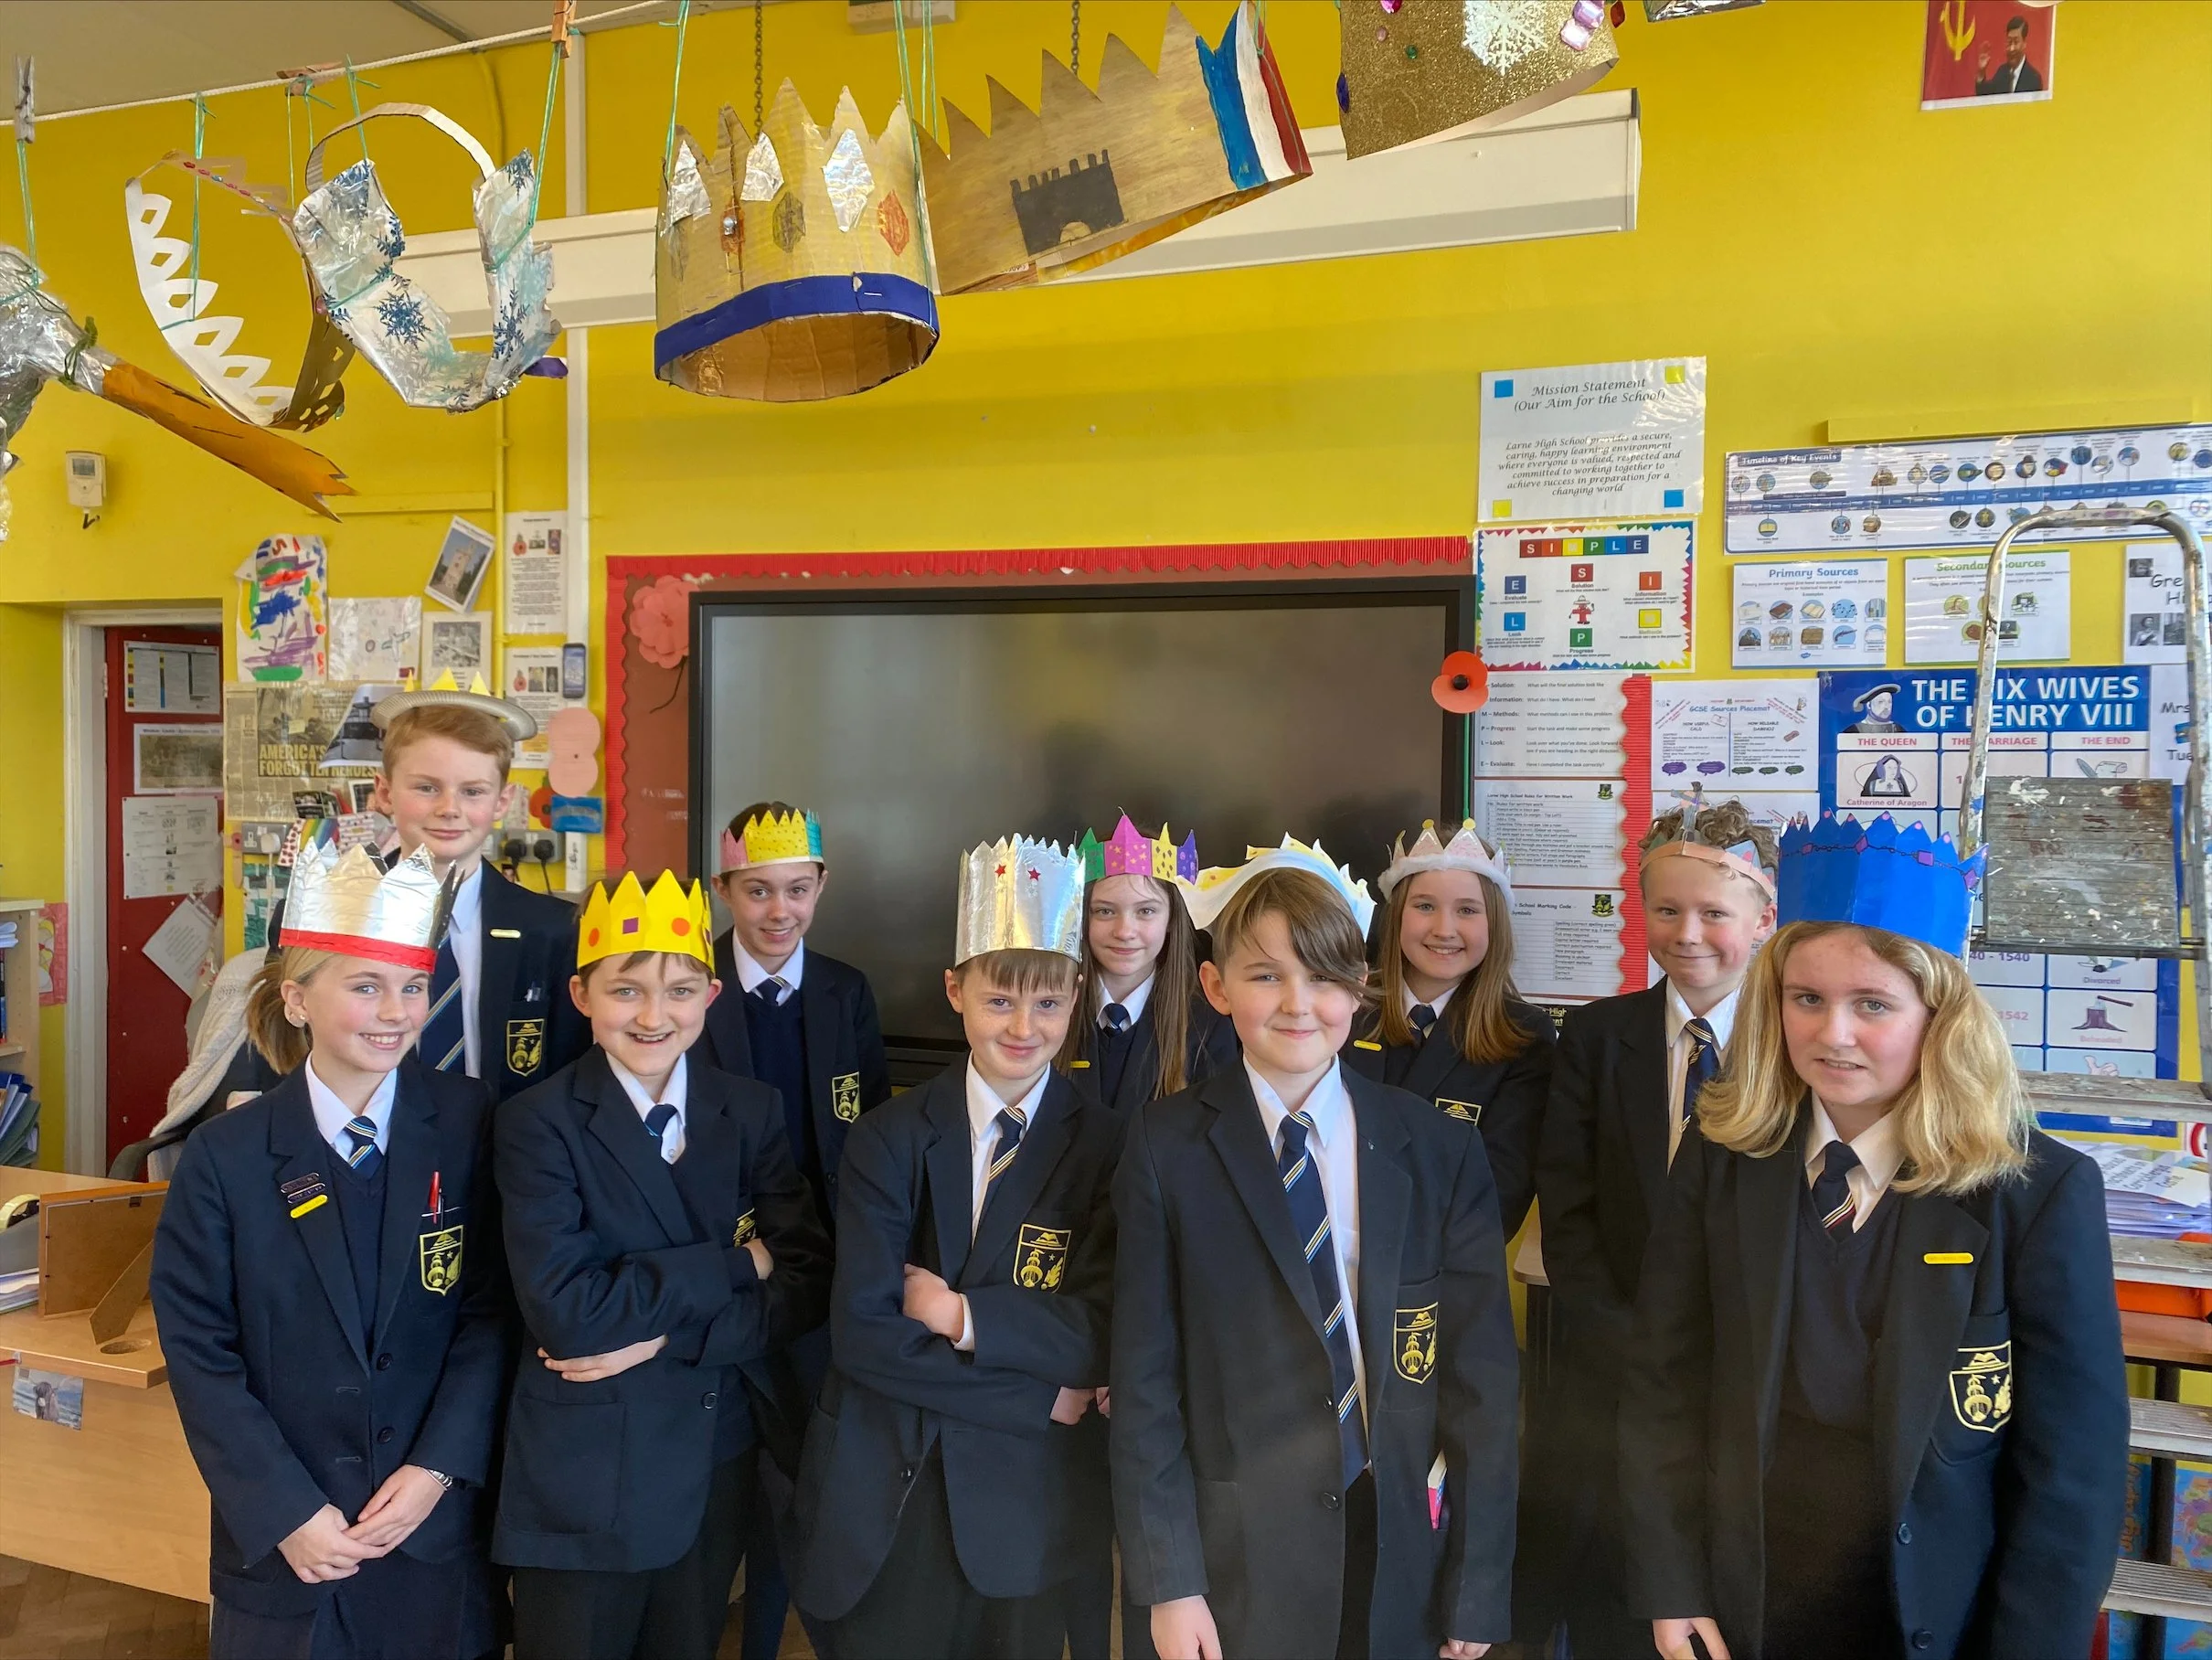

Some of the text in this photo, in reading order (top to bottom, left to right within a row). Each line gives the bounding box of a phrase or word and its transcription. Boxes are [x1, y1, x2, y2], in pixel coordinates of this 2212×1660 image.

[1531, 378, 1645, 397] Mission Statement
[1514, 389, 1665, 412] (Our Aim for the School)
[1506, 442, 1532, 451] Larne
[1535, 439, 1557, 450] High
[1559, 437, 1588, 446] School
[1506, 442, 1672, 461] caring, happy learning environment
[1742, 452, 1837, 465] Timeline of Key Events
[1498, 462, 1526, 470] where
[1527, 459, 1568, 469] everyone
[1581, 455, 1613, 464] valued,
[1617, 452, 1660, 463] respected
[1663, 451, 1681, 459] and
[1513, 468, 1559, 478] committed
[1574, 465, 1611, 474] working
[1615, 463, 1653, 473] together
[1507, 479, 1541, 489] achieve
[1544, 477, 1575, 486] success
[1578, 476, 1587, 484] in
[1590, 474, 1644, 485] preparation
[1647, 472, 1661, 482] for
[1552, 484, 1623, 496] changing world
[1769, 568, 1858, 579] Primary Sources
[1937, 562, 1988, 571] Secondar
[2153, 574, 2183, 588] Gre
[1912, 676, 2140, 701] THE IX WIVES
[1917, 706, 1954, 727] OF
[2080, 703, 2133, 726] VIII
[260, 744, 327, 760] AMERICA'S
[1898, 799, 1927, 807] Aragon
[1999, 952, 2030, 962] 1540
[2083, 976, 2121, 985] Divorced
[1998, 1011, 2029, 1021] 1542
[2079, 1035, 2122, 1044] Beheaded
